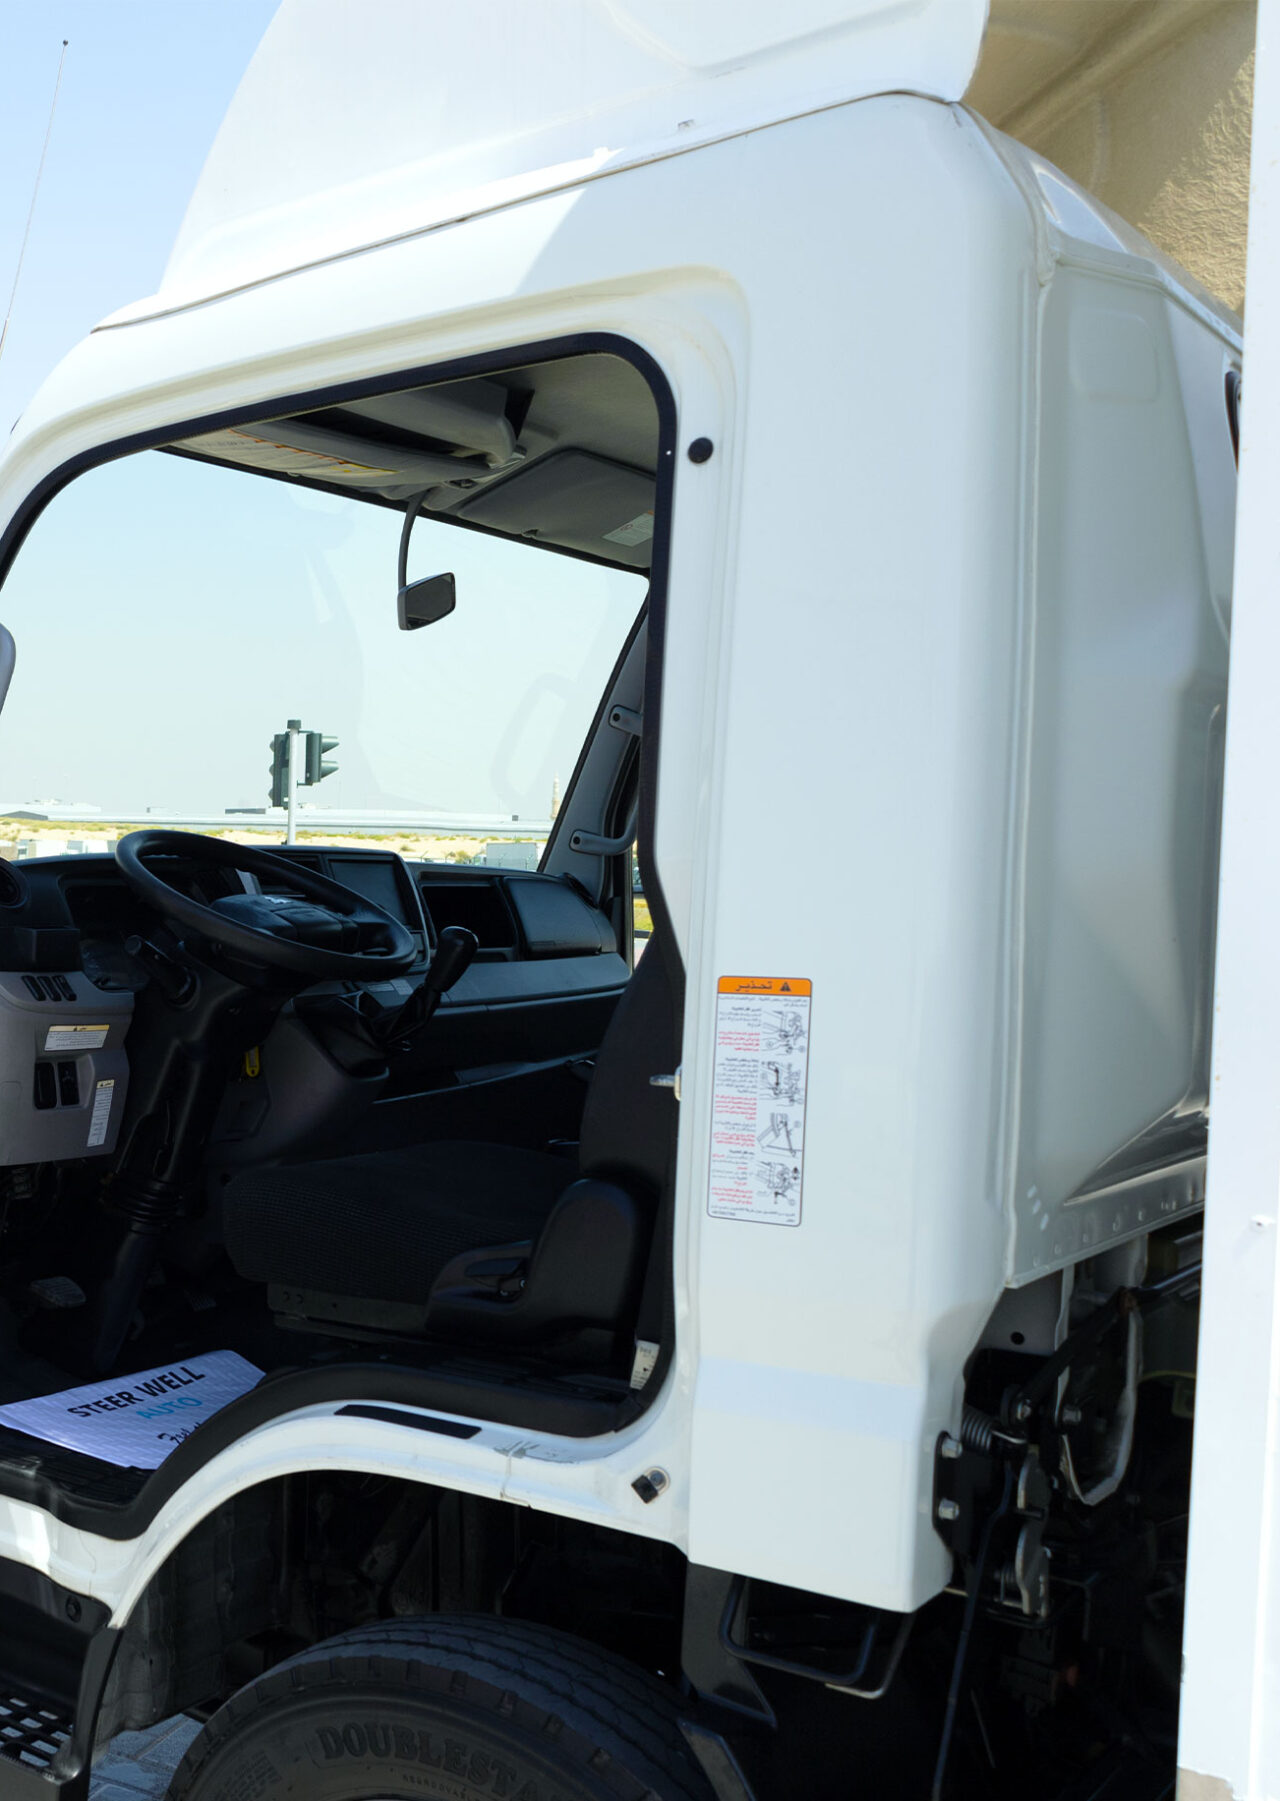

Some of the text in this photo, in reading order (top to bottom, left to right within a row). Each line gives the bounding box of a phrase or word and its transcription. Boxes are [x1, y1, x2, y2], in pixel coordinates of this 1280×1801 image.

[67, 1366, 206, 1418] STEER WELL
[135, 1397, 203, 1420] AUTO
[315, 1721, 562, 1801] DOUBLESTA
